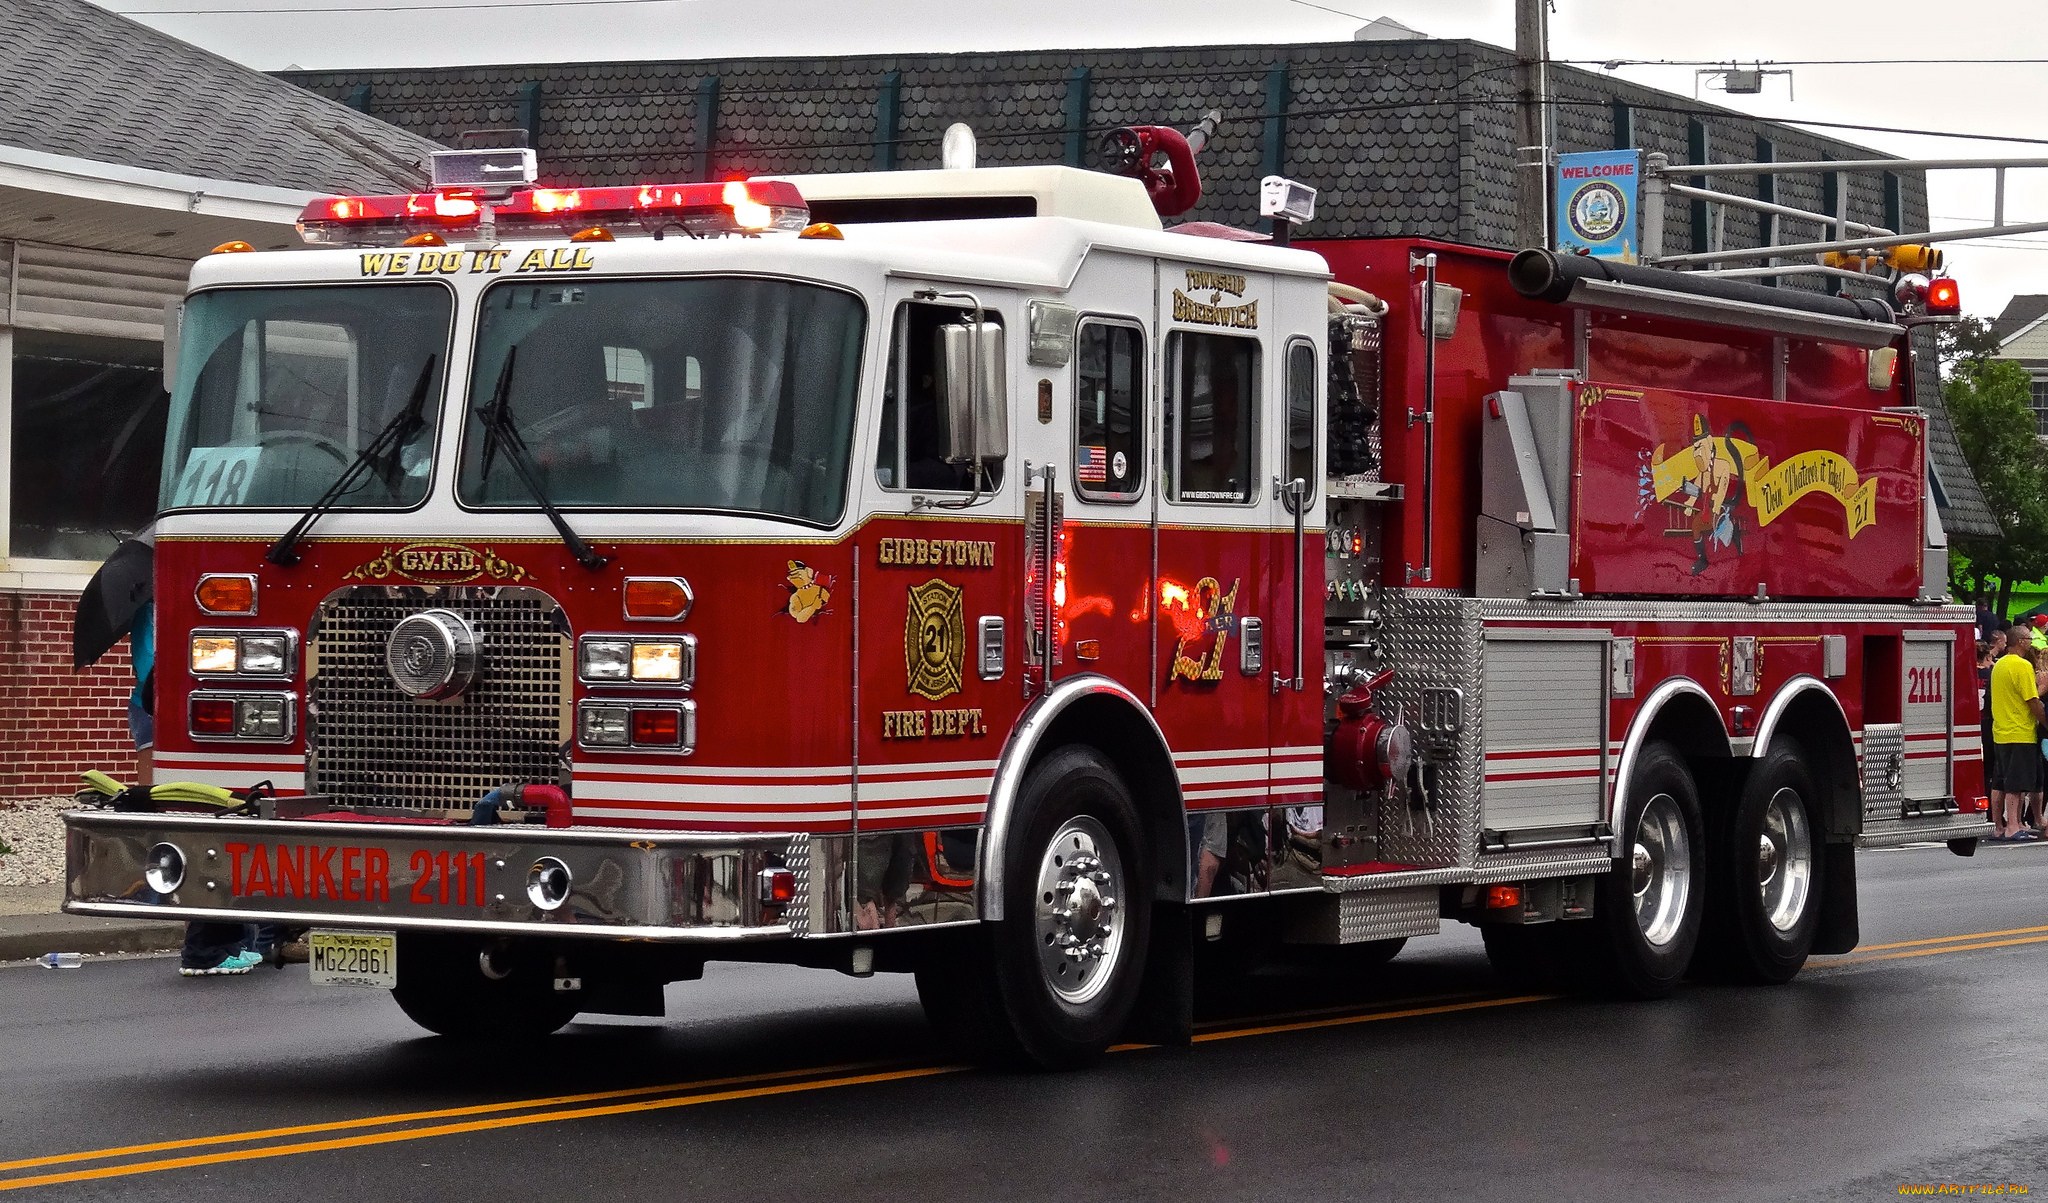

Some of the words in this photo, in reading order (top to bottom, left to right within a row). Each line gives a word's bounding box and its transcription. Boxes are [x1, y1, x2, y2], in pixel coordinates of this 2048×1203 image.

[1562, 164, 1634, 179] WELCOME
[360, 252, 413, 276] WE
[414, 251, 463, 275] DO
[468, 249, 511, 274] IT
[515, 247, 595, 273] ALL
[1185, 269, 1247, 298] TOWNSHIP
[1172, 287, 1259, 330] GREENWICH
[184, 459, 248, 506] 118
[1820, 455, 1827, 483] it
[1854, 497, 1868, 530] 21
[402, 551, 481, 571] G.V.F.D.
[878, 538, 996, 567] GIBBSTOWN
[922, 591, 948, 605] STATION
[925, 624, 945, 653] 21
[1907, 667, 1942, 704] 2111
[882, 710, 927, 739] FIRE
[930, 708, 988, 737] DEPT.
[225, 842, 390, 903] TANKER
[410, 849, 486, 907] 2111
[315, 946, 389, 975] MG22861
